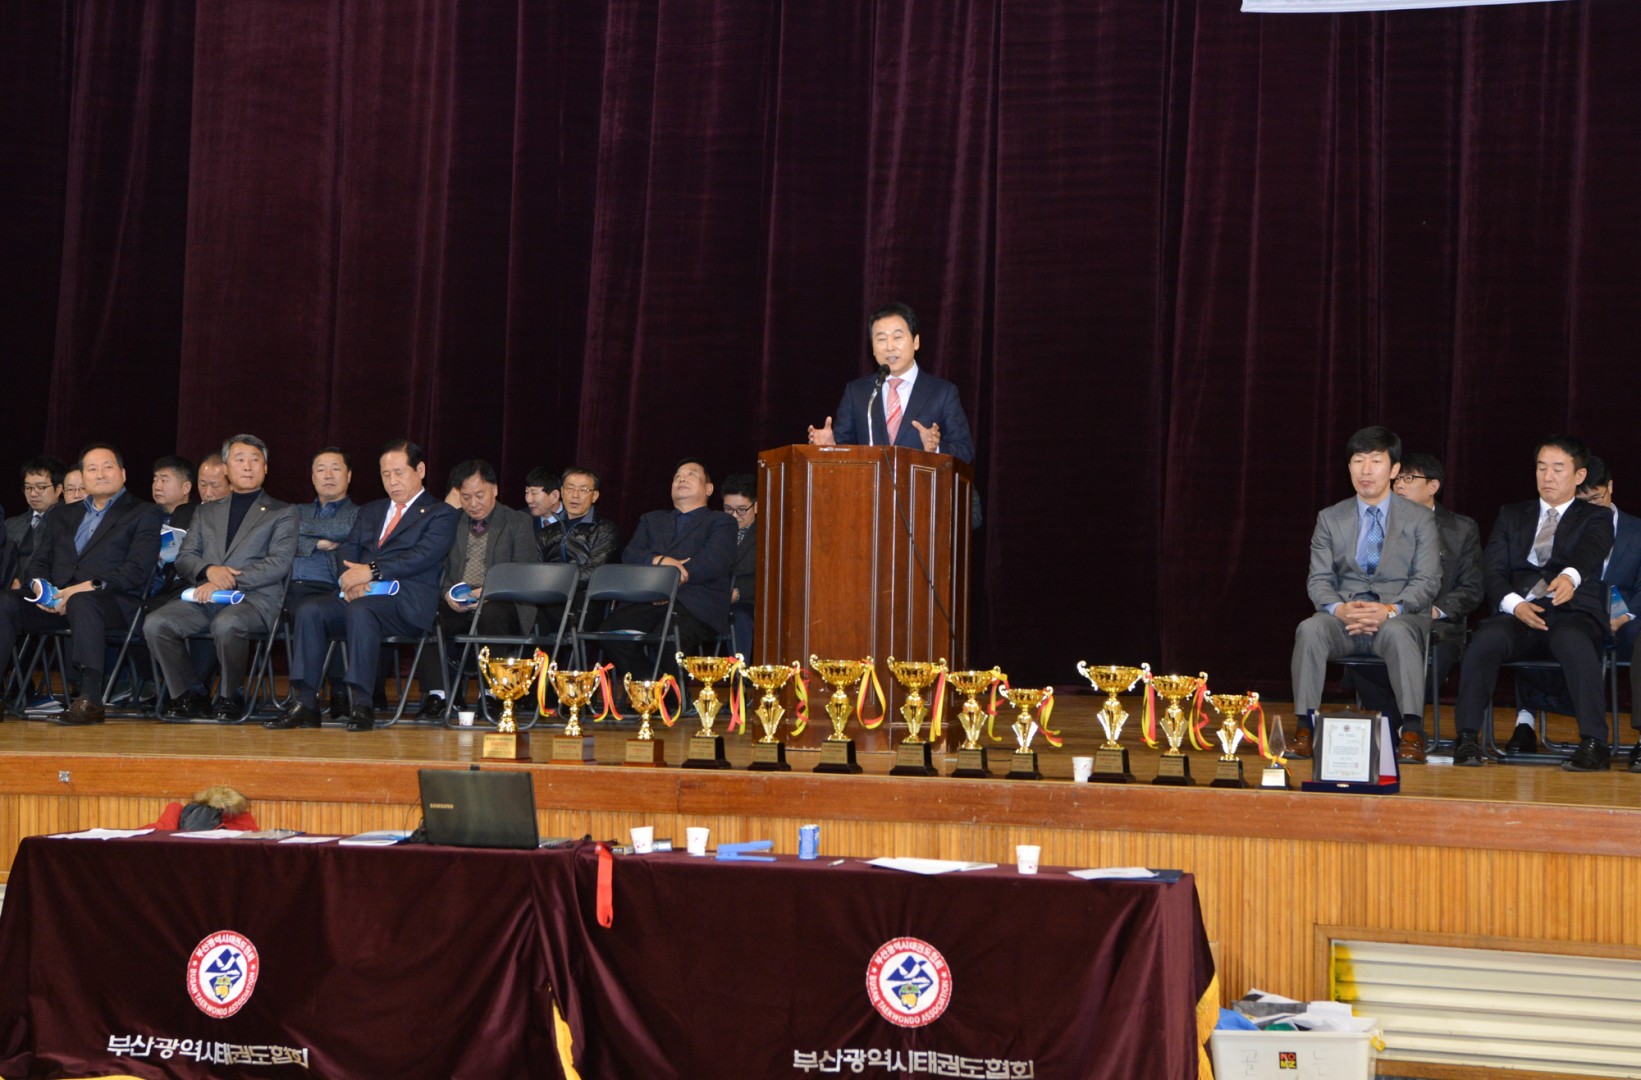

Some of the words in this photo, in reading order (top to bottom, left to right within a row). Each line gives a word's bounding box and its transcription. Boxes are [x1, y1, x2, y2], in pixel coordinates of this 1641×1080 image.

[874, 940, 944, 970] 부산광역시태권도협회
[189, 968, 199, 994] BUSAN
[194, 992, 228, 1015] TAEKWONDO
[228, 972, 256, 1014] ASSOCIATION
[869, 975, 880, 1002] BUSAN
[877, 1000, 920, 1024] TAEKWONDO
[921, 980, 949, 1022] ASSOCIATION
[107, 1035, 309, 1069] 부산광역시태권도협회
[793, 1048, 1034, 1080] 부산광역시태권도협회
